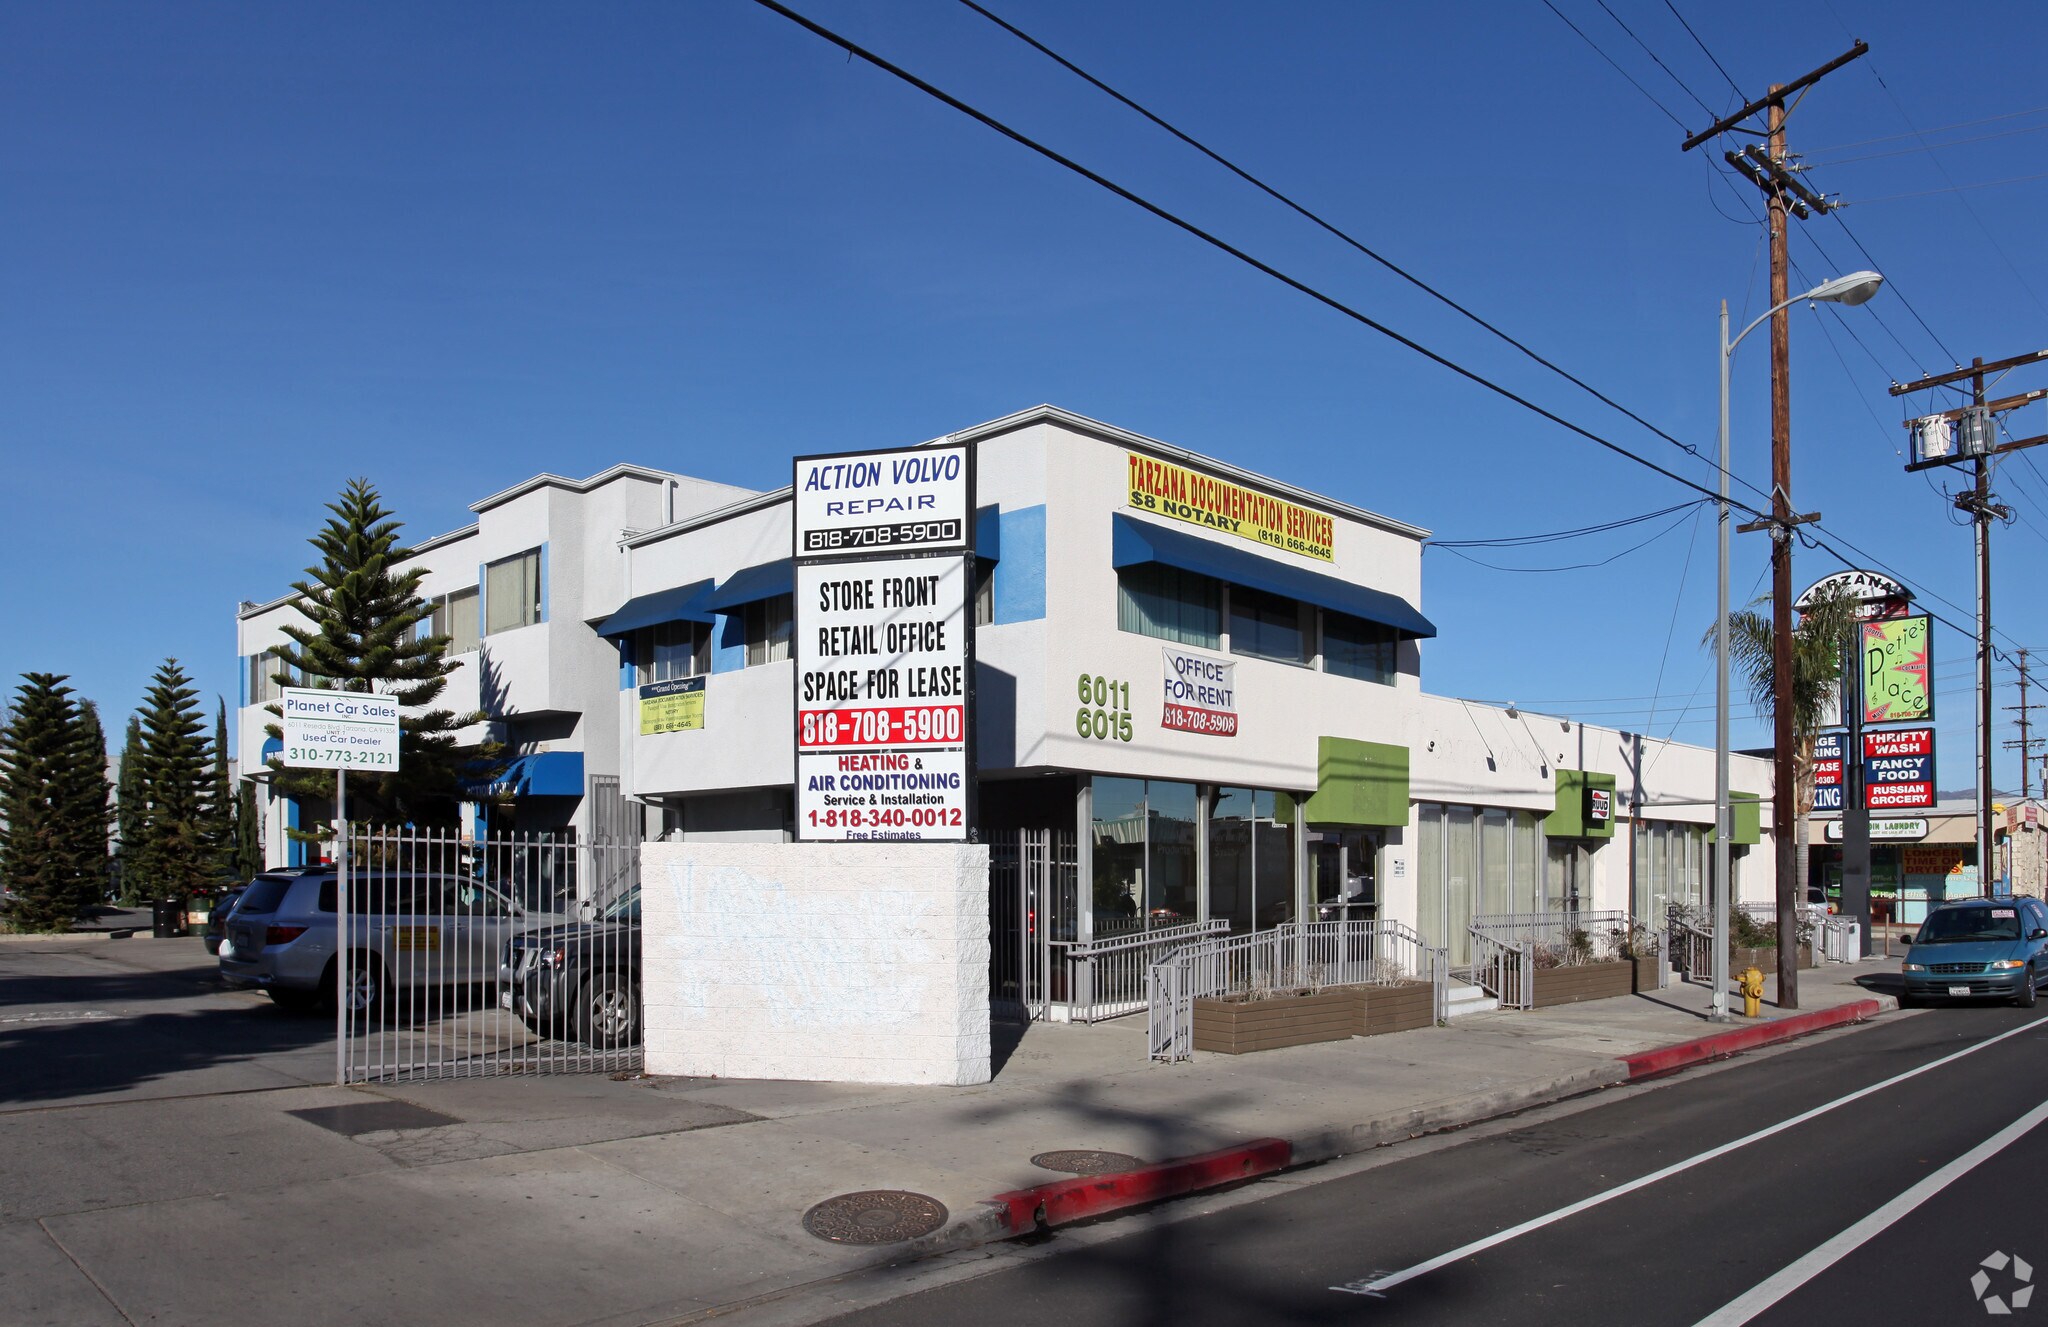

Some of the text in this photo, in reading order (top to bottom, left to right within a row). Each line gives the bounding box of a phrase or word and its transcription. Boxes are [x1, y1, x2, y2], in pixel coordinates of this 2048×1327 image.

[805, 454, 960, 491] ACTION VOLVO
[827, 494, 936, 516] REPAIR
[1129, 455, 1333, 548] TARZANA DOCUMENTATION SERVICES
[809, 521, 956, 548] 818-708-5900
[1131, 491, 1332, 559] $8 NOTARY (818) 666-4645
[819, 575, 939, 612] STORE FRONT
[1175, 656, 1223, 682] OFFICE
[803, 665, 962, 702] SPACE FOR LEASE
[1077, 673, 1129, 711] 6011
[1165, 679, 1233, 707] FOR RENT
[287, 699, 396, 718] Planet Car Sales
[803, 707, 960, 744] 818-708-5900
[1076, 707, 1133, 742] 6015
[1164, 706, 1235, 733] 818-708-5908
[302, 733, 381, 745] Used Car Dealer
[1866, 731, 1929, 744] THRIFTY
[289, 747, 392, 764] 310-773-2121
[1875, 743, 1920, 754] WASH
[838, 753, 923, 772] HEATING &
[1872, 758, 1925, 770] FANCY
[808, 772, 961, 791] AIR CONDITIONING
[1877, 770, 1920, 781] FOOD
[824, 793, 945, 806] Service & Installation
[1873, 785, 1925, 795] RUSSIAN
[1592, 800, 1608, 811] RUUD
[1870, 795, 1928, 805] GROCERY
[808, 808, 962, 828] 1-818-340-0012
[1884, 822, 1920, 830] LAUNDRY
[846, 829, 922, 840] Free Estimates
[1904, 849, 1960, 857] LONGER
[1904, 857, 1937, 865] TIME
[1905, 866, 1959, 874] DRYERS
